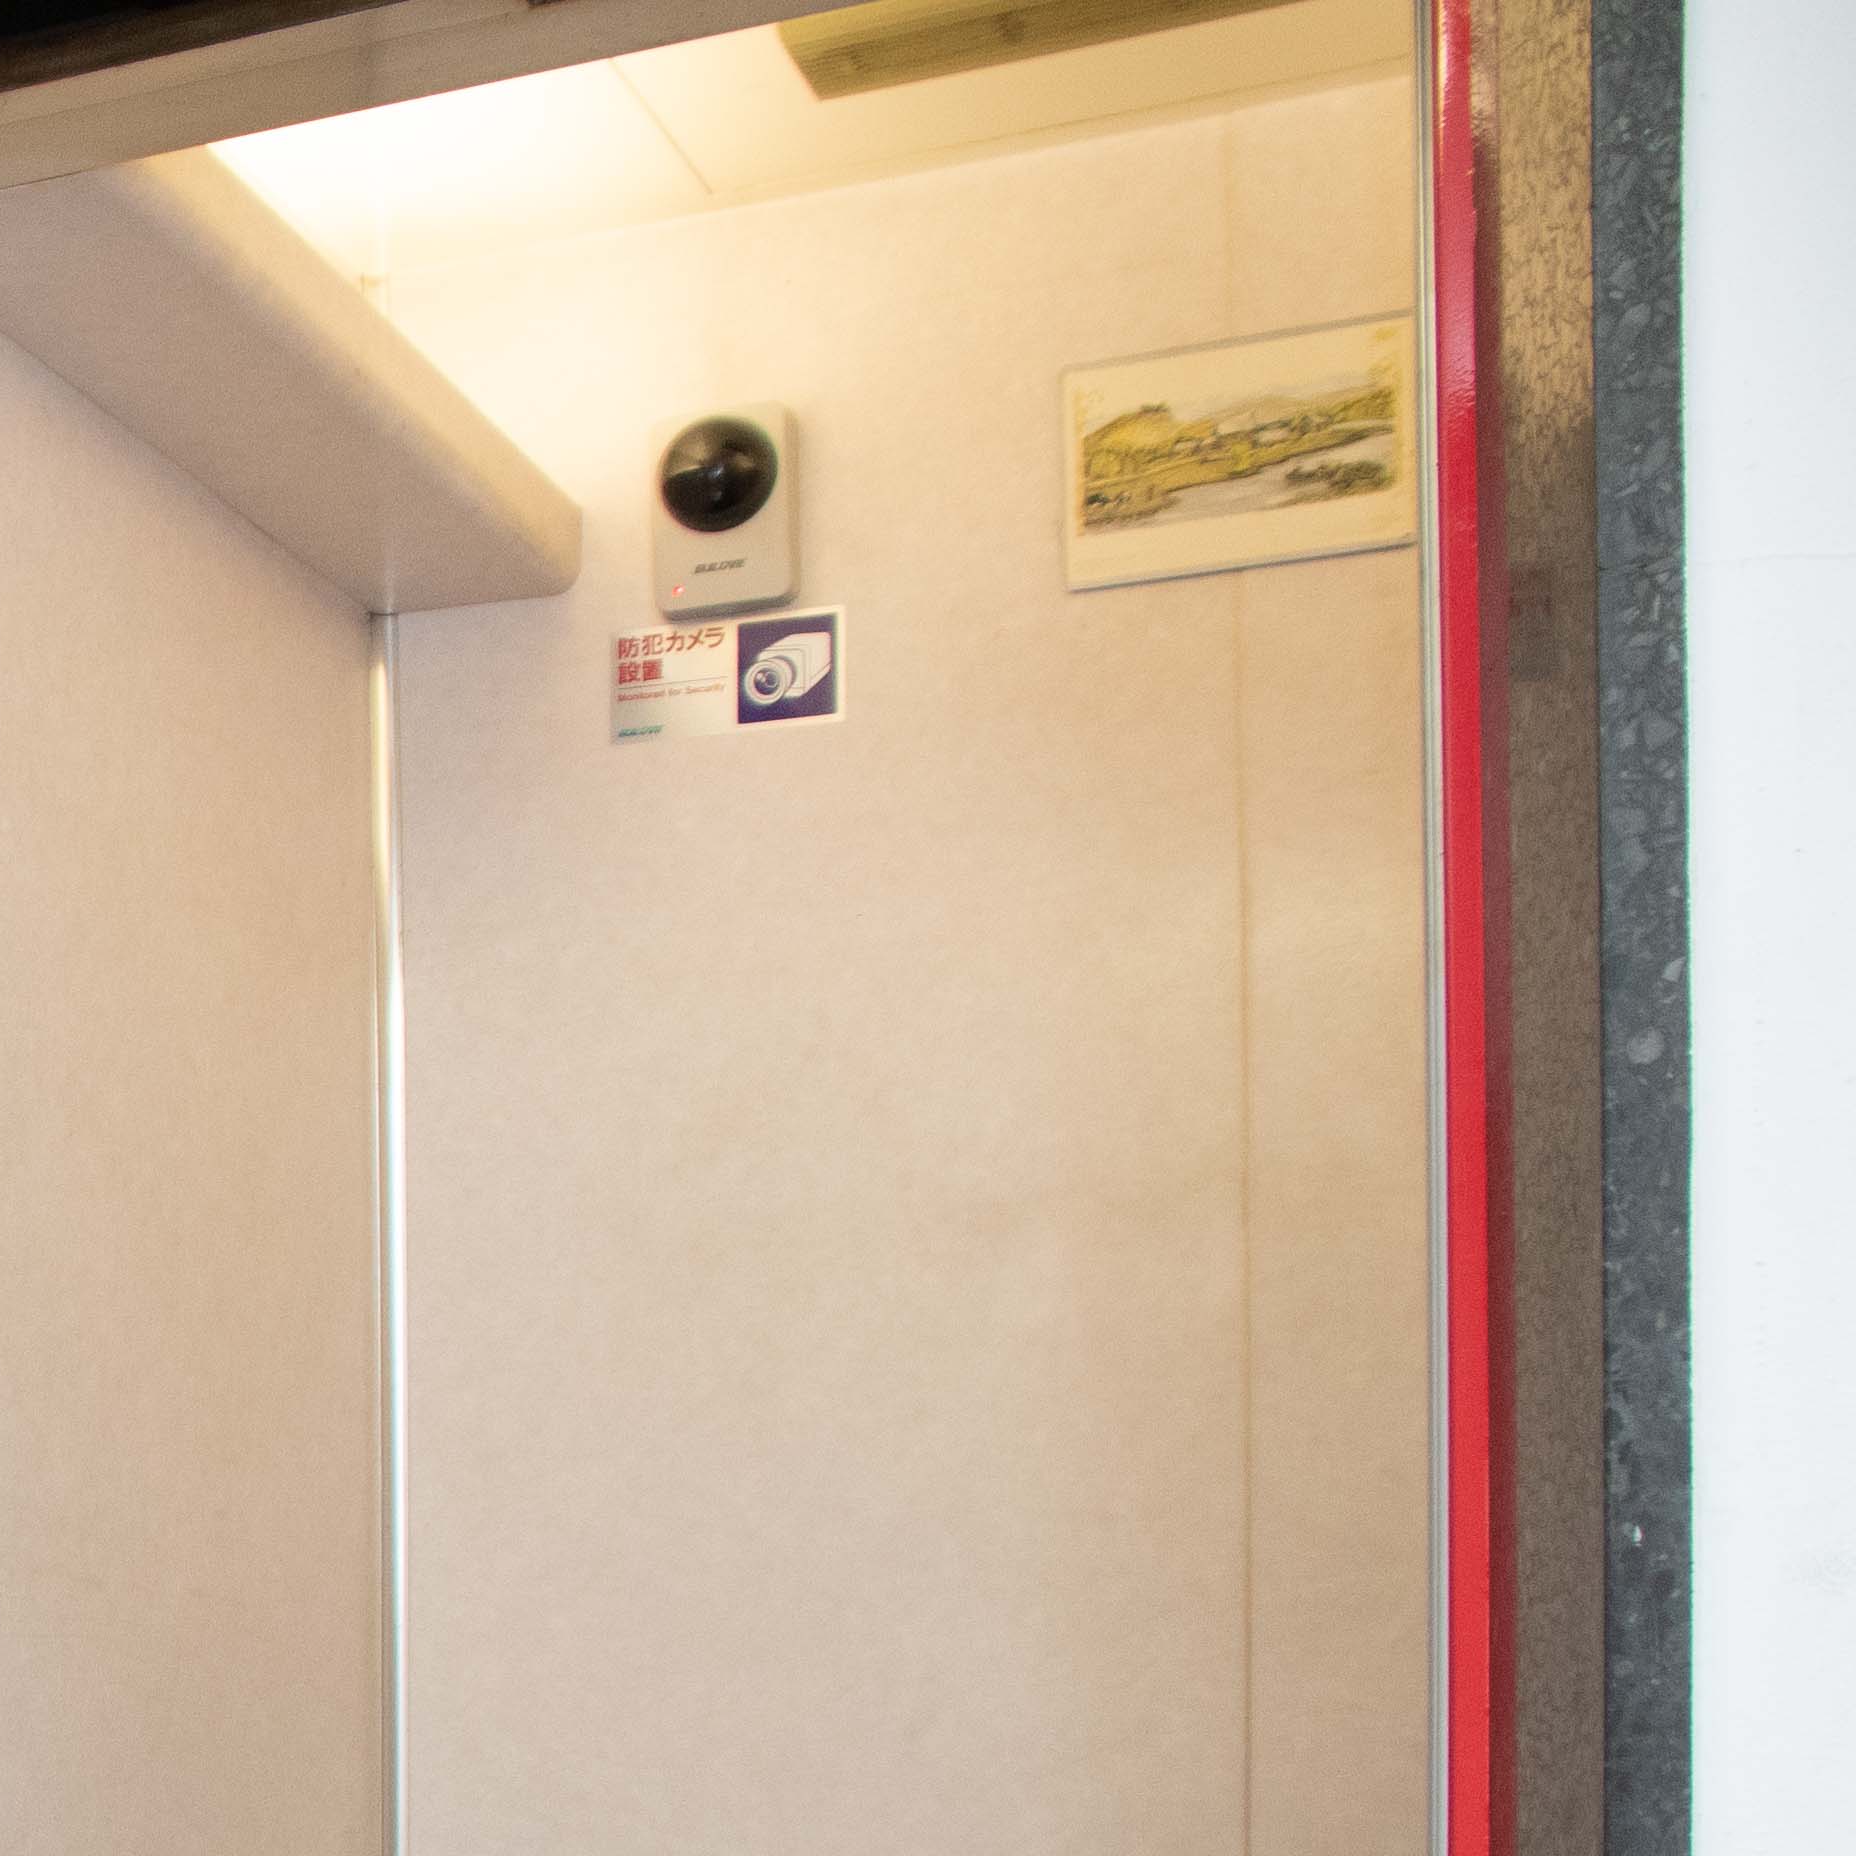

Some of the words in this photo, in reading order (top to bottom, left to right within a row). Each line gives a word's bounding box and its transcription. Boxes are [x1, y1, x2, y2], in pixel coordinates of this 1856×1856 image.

[618, 626, 726, 659] 防犯カメラ
[618, 658, 664, 685] 設置
